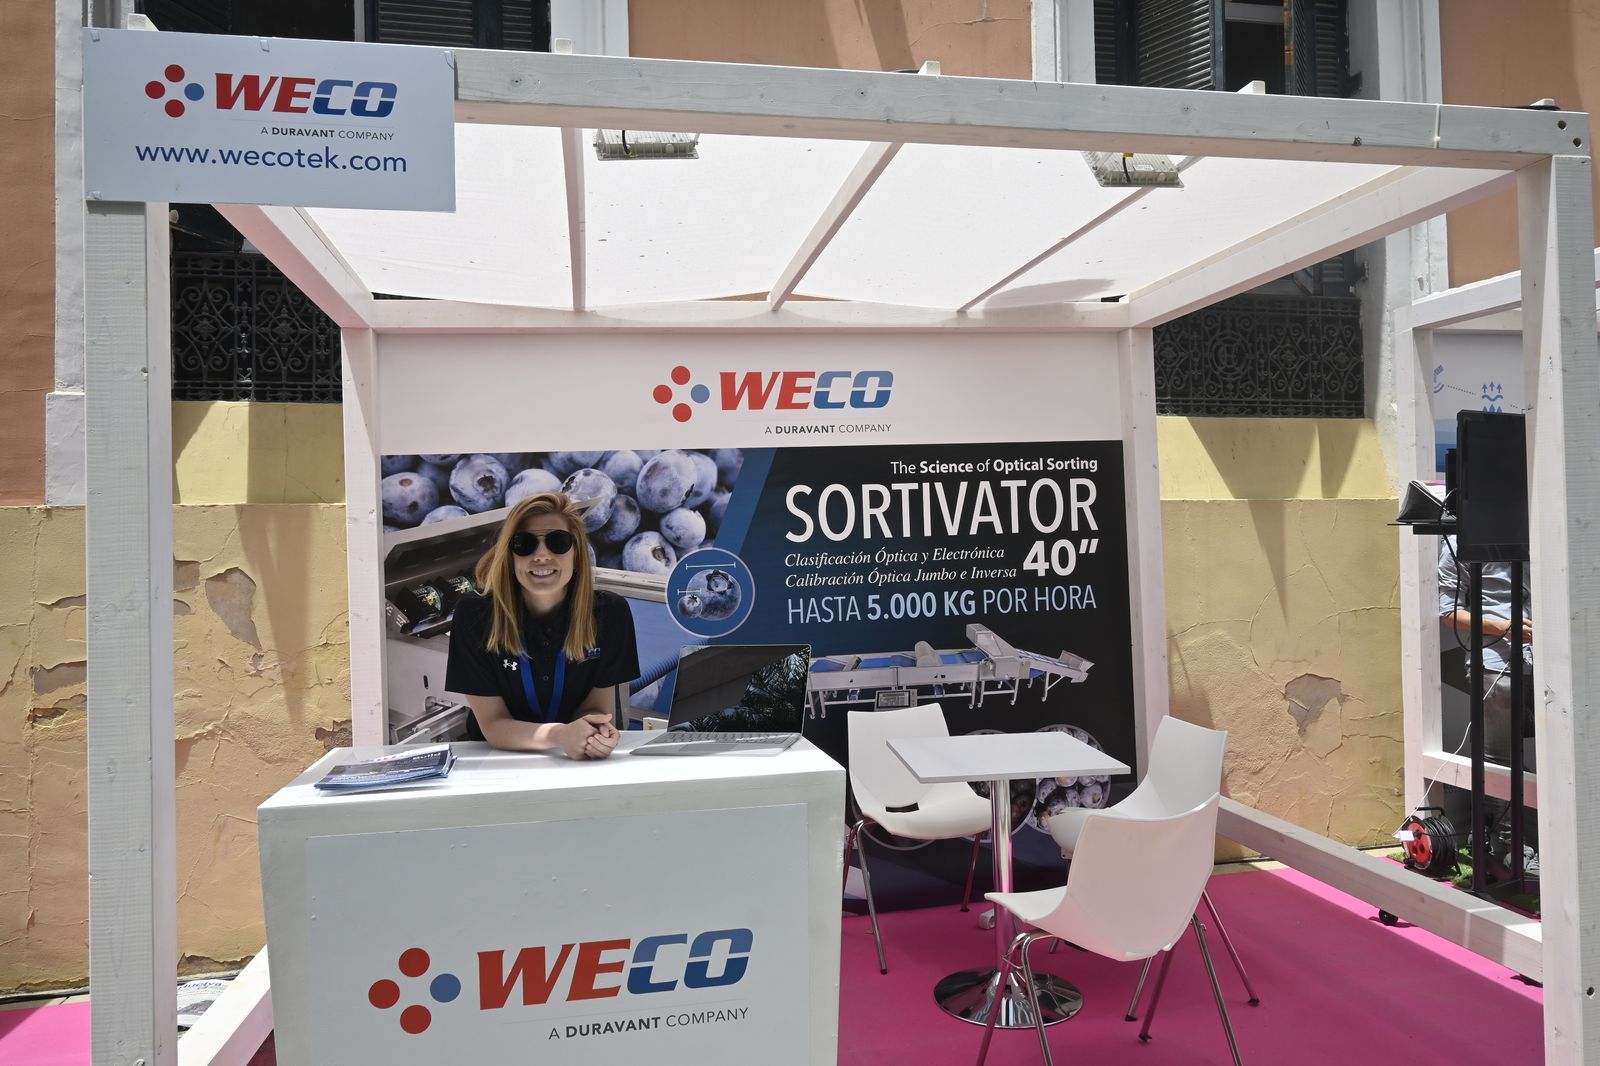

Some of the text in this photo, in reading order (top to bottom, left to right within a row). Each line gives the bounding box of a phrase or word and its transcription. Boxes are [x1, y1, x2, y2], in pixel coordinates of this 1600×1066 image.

[215, 73, 397, 117] WECO
[260, 127, 394, 141] A DURAVANT COMPANY
[135, 146, 407, 172] www.wecotek.com
[720, 371, 894, 410] WECO
[764, 424, 892, 434] A DURAVANT COMPANY
[890, 457, 1098, 474] The Science of Optical Sorting
[785, 477, 1099, 543] SORTIVATOR
[784, 546, 1005, 568] Clasificación Óptica y Electrónica
[786, 567, 1017, 588] Calibración Óptica Jumbo e Inversa
[788, 584, 1097, 624] HASTA 5.000 KG POR HORA
[478, 928, 754, 1010] WECO
[548, 1008, 749, 1040] A DURAVANT COMPANY
